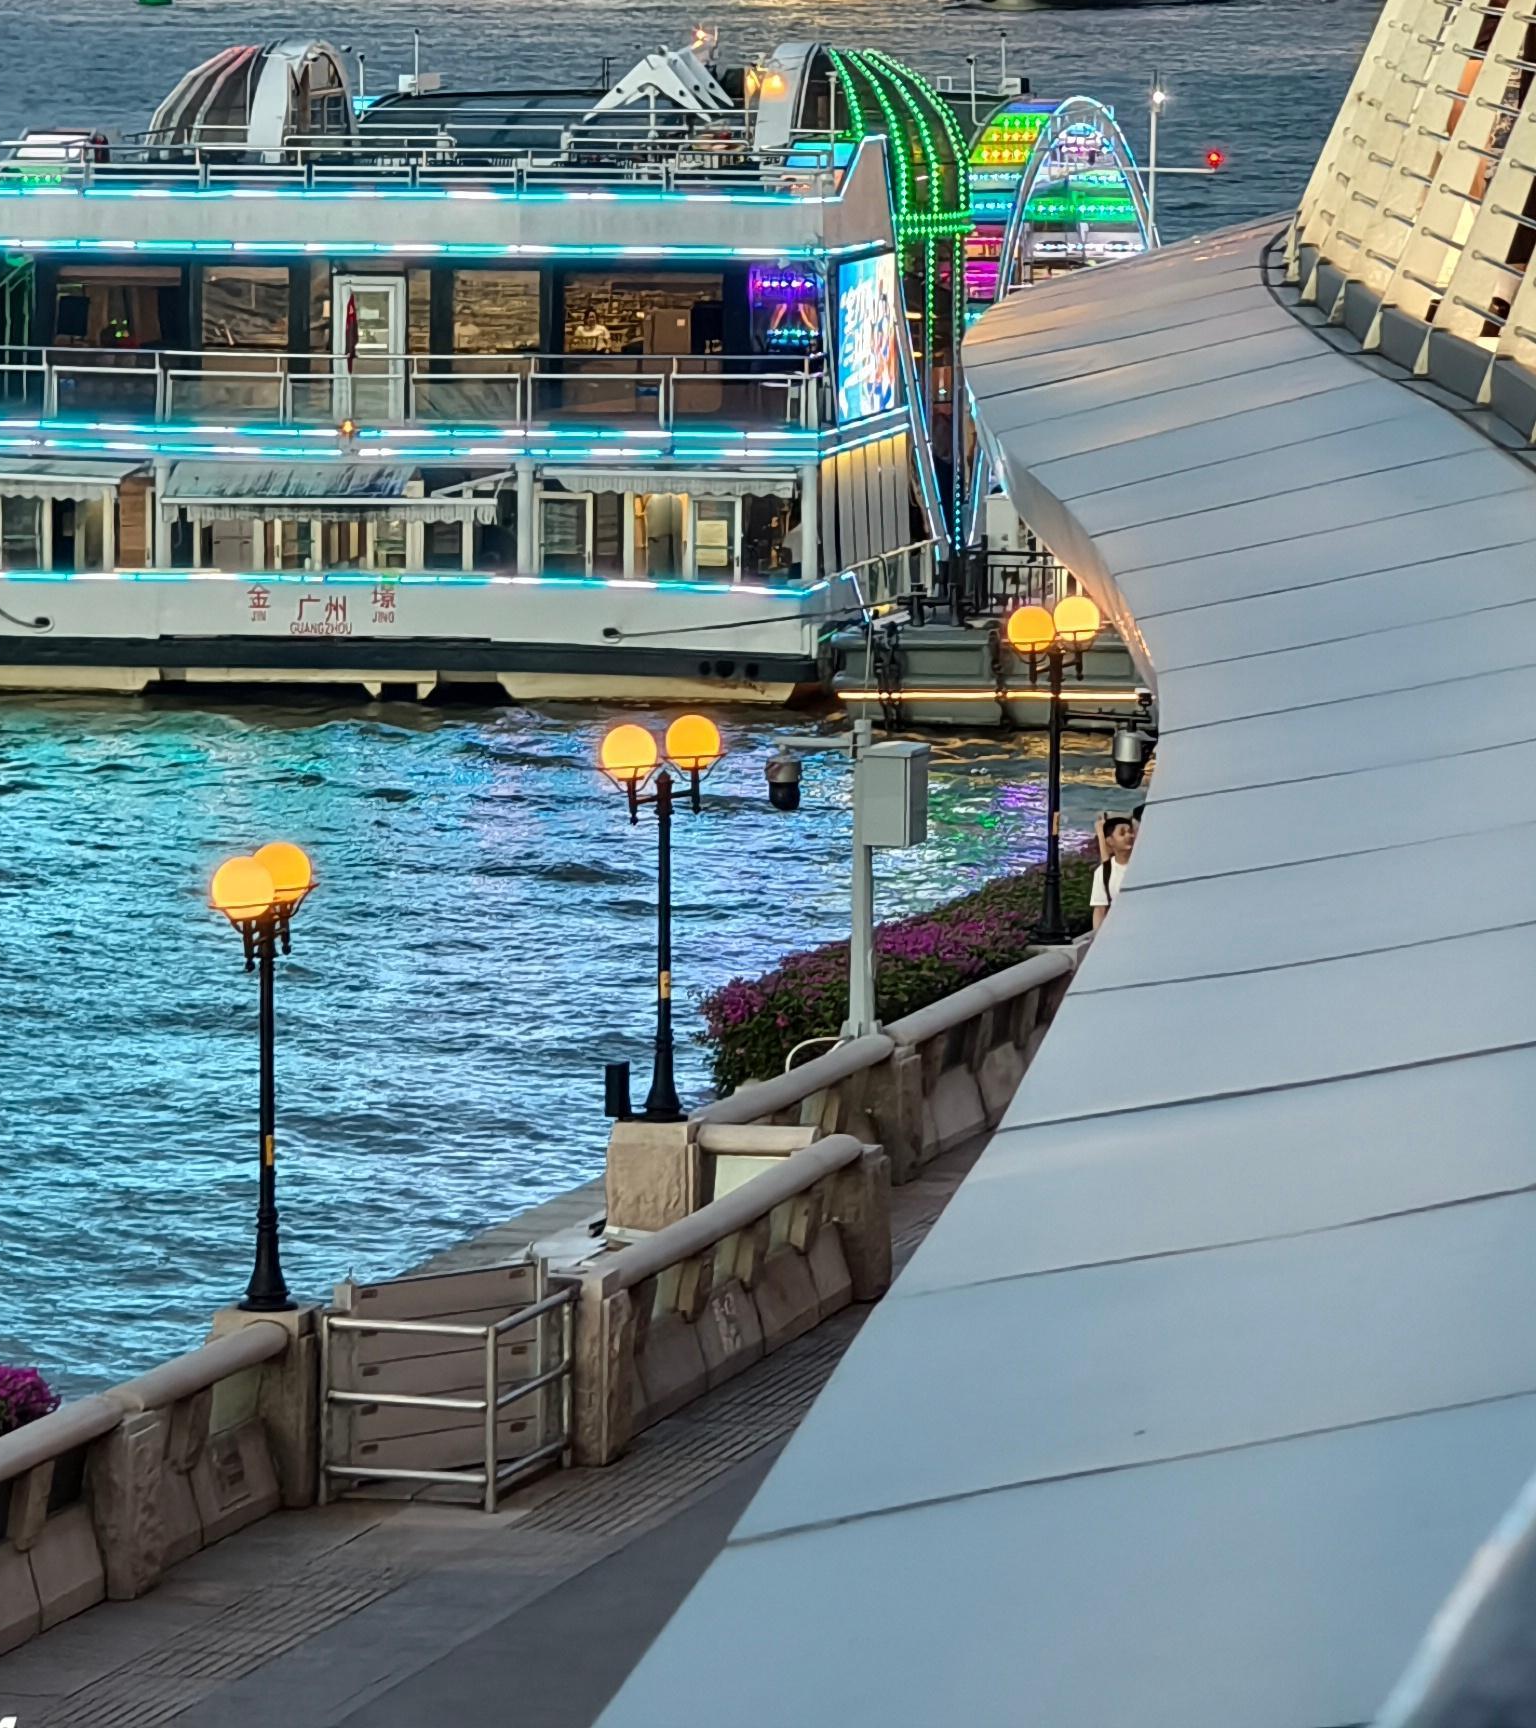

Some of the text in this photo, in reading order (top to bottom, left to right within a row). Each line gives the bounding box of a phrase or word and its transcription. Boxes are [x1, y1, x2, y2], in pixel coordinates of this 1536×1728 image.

[247, 582, 271, 609] 金
[251, 611, 267, 622] JIN
[297, 593, 347, 622] 广州
[289, 622, 353, 635] GUANGZHOU
